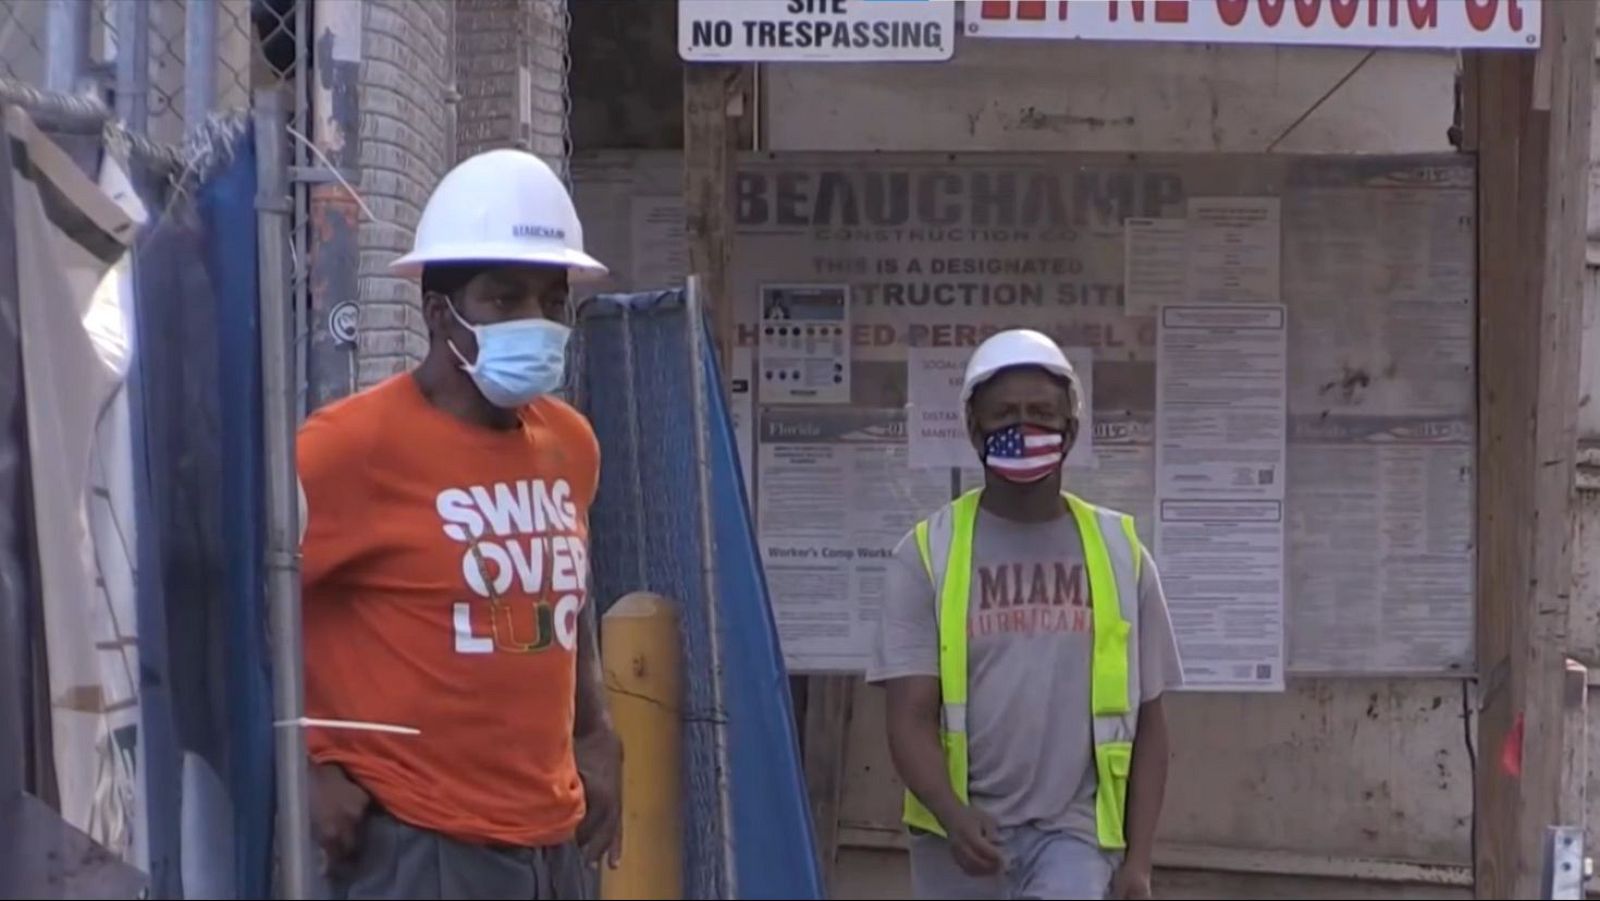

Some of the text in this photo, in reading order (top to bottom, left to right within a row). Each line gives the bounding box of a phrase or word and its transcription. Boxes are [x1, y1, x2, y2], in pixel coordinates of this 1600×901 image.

[692, 20, 942, 48] NO TRESPASSING
[735, 171, 1184, 226] BEAUCHAMP
[814, 228, 1030, 242] CONSTRUCTION
[813, 257, 1083, 275] THIS IS A DESIGNATED
[851, 283, 1043, 306] TRUCTION
[436, 479, 577, 542] SWAG
[978, 562, 1093, 610] MIAM
[453, 593, 580, 654] LUC
